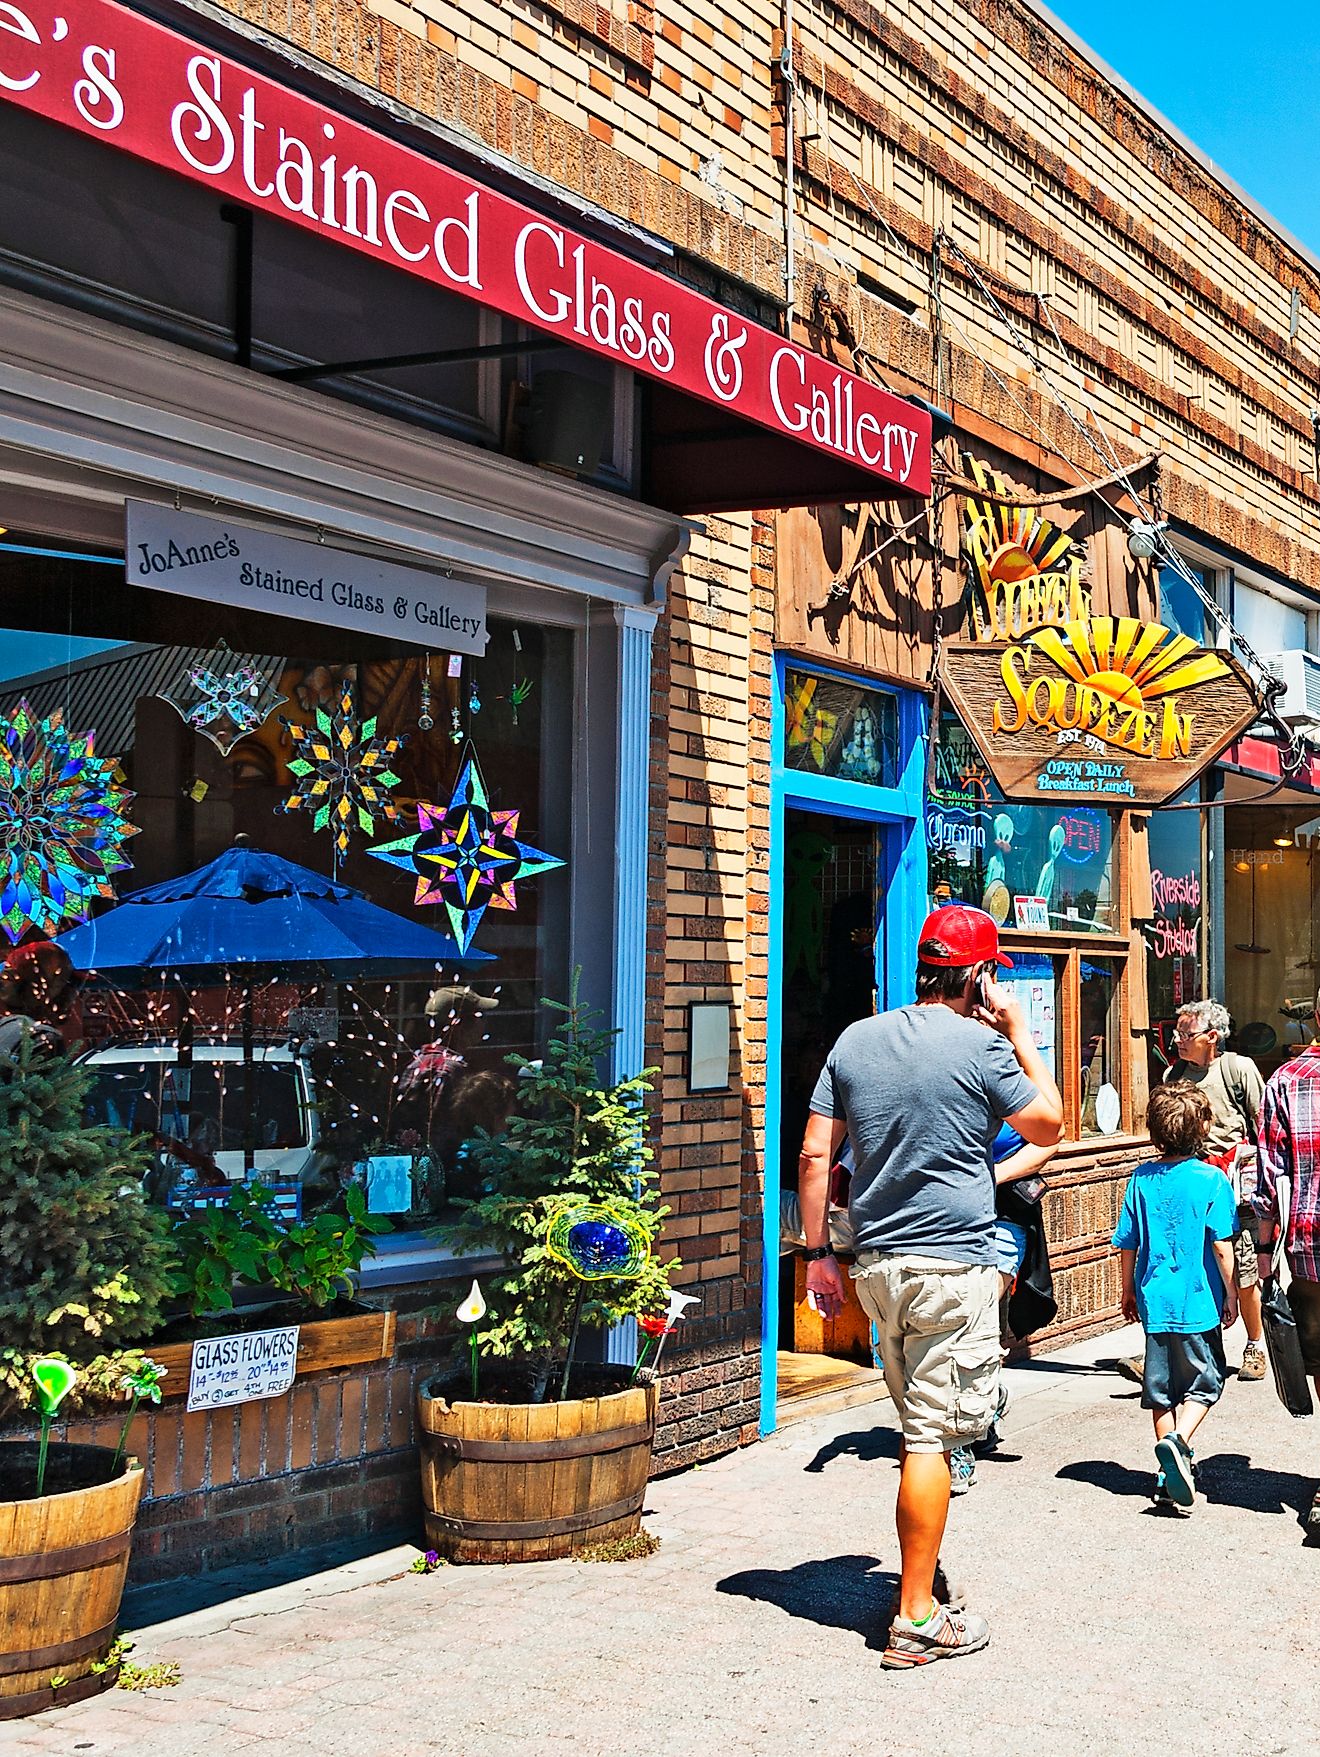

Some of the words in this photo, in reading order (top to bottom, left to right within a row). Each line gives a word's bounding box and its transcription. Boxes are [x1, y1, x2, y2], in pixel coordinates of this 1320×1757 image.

[170, 55, 484, 291] Stained
[514, 222, 675, 373] Glass
[704, 312, 748, 401] &
[769, 347, 918, 483] Gallery
[138, 533, 240, 575] JoAnne's
[239, 562, 325, 602] Stained
[331, 582, 385, 614] Glass
[393, 597, 409, 619] &
[414, 601, 482, 638] Gallery
[992, 644, 1157, 759] SQUEEZE
[1157, 696, 1197, 760] IN
[1084, 733, 1107, 756] 1974
[1046, 760, 1084, 779] OPEN
[1085, 761, 1126, 778] DAILY
[1096, 778, 1136, 797] Lunch
[1231, 849, 1285, 864] Hand
[1155, 917, 1197, 959] Studios
[195, 1340, 239, 1370] GLASS
[242, 1332, 295, 1362] FLOWERS
[191, 1391, 209, 1406] BUY
[224, 1389, 240, 1398] GET
[267, 1378, 291, 1393] FREE
